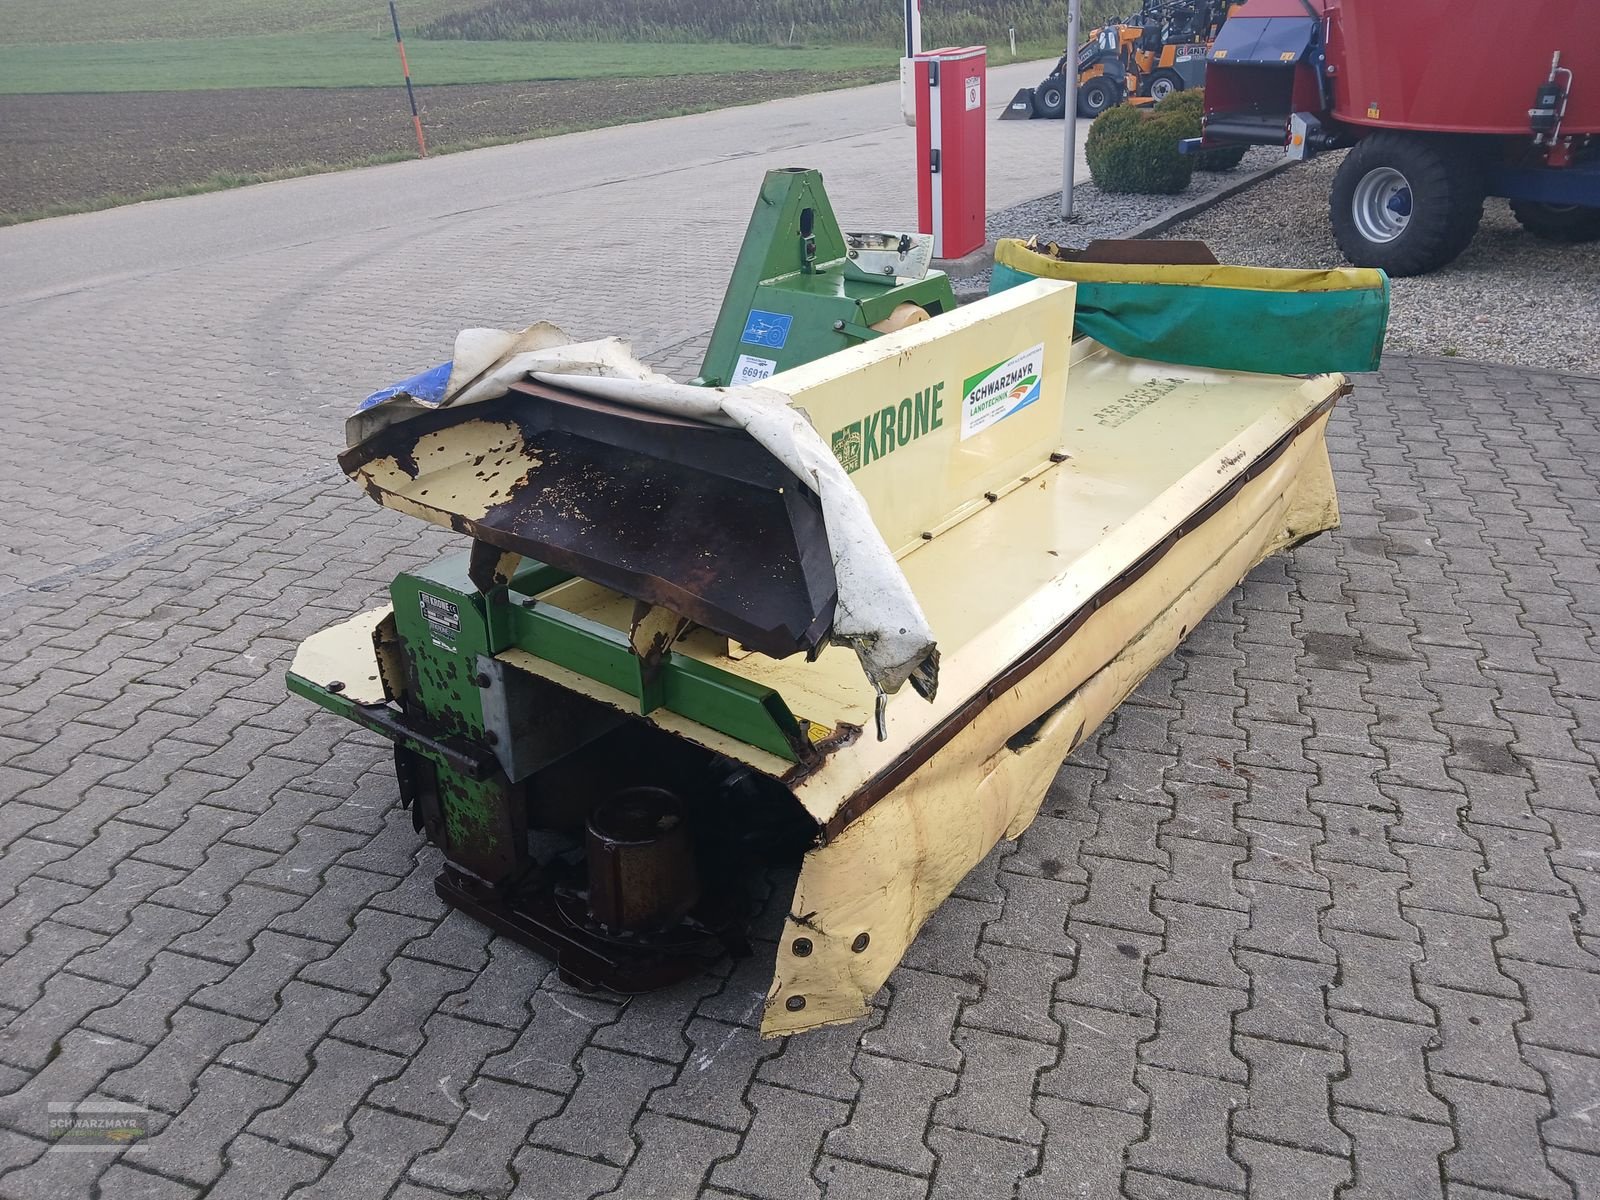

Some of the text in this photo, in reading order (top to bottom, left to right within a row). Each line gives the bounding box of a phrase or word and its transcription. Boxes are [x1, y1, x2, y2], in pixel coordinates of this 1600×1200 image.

[742, 366, 769, 379] 66916
[970, 363, 1033, 405] SCHWARZMAYR
[970, 391, 1009, 416] LANDTECHNIK
[863, 380, 945, 467] KRONE
[430, 597, 450, 612] KRONE
